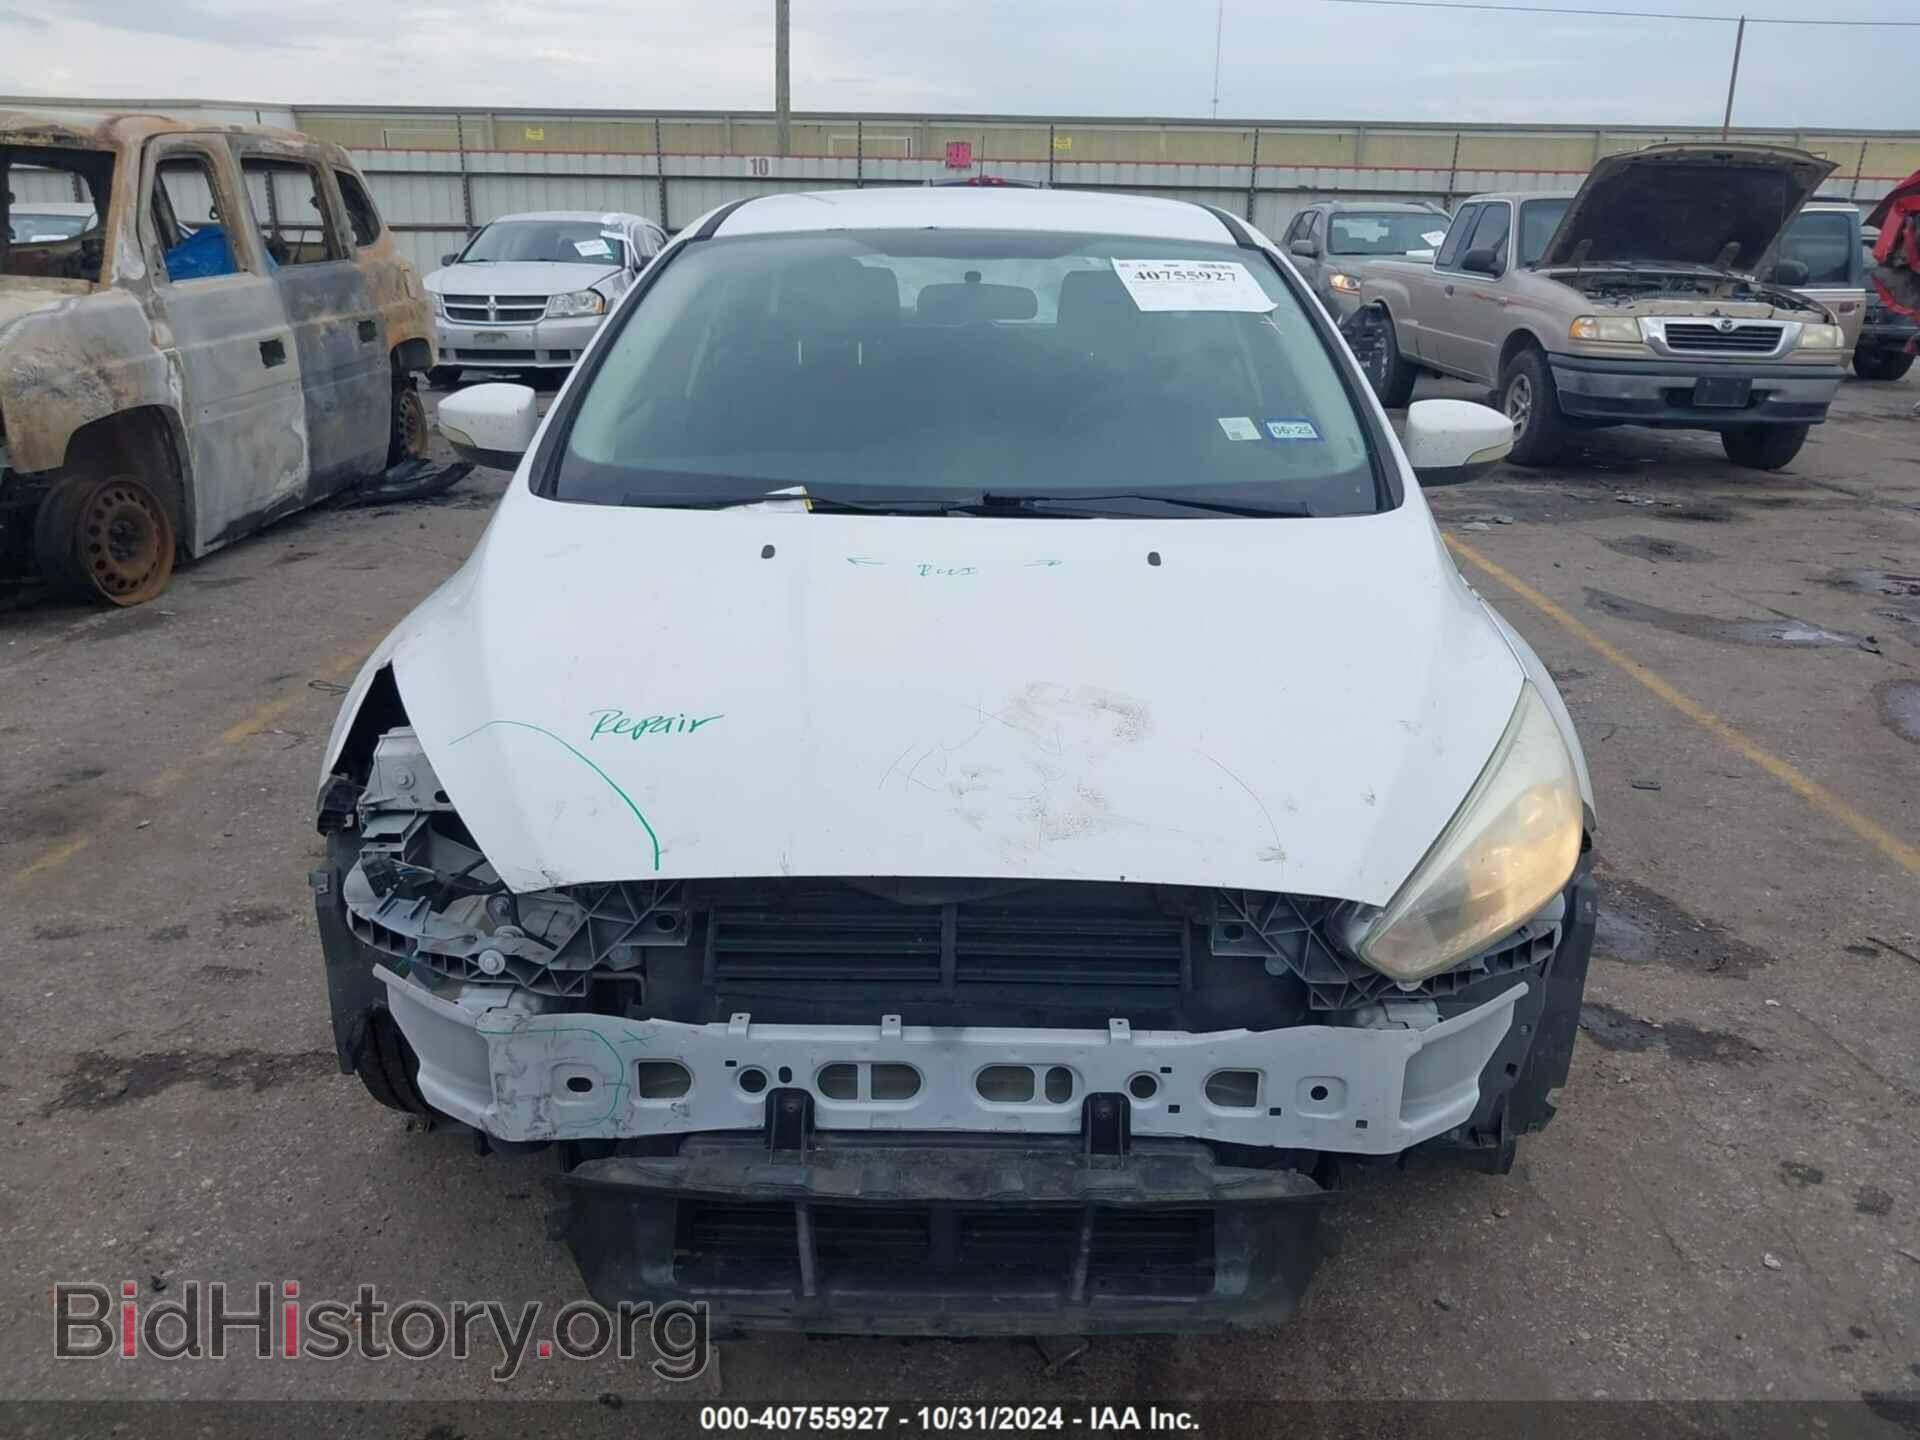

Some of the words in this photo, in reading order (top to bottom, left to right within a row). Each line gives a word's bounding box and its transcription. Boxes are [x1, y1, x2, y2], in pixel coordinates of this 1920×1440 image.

[750, 158, 768, 176] 10
[1133, 270, 1237, 281] 40755927
[589, 708, 725, 741] Repair
